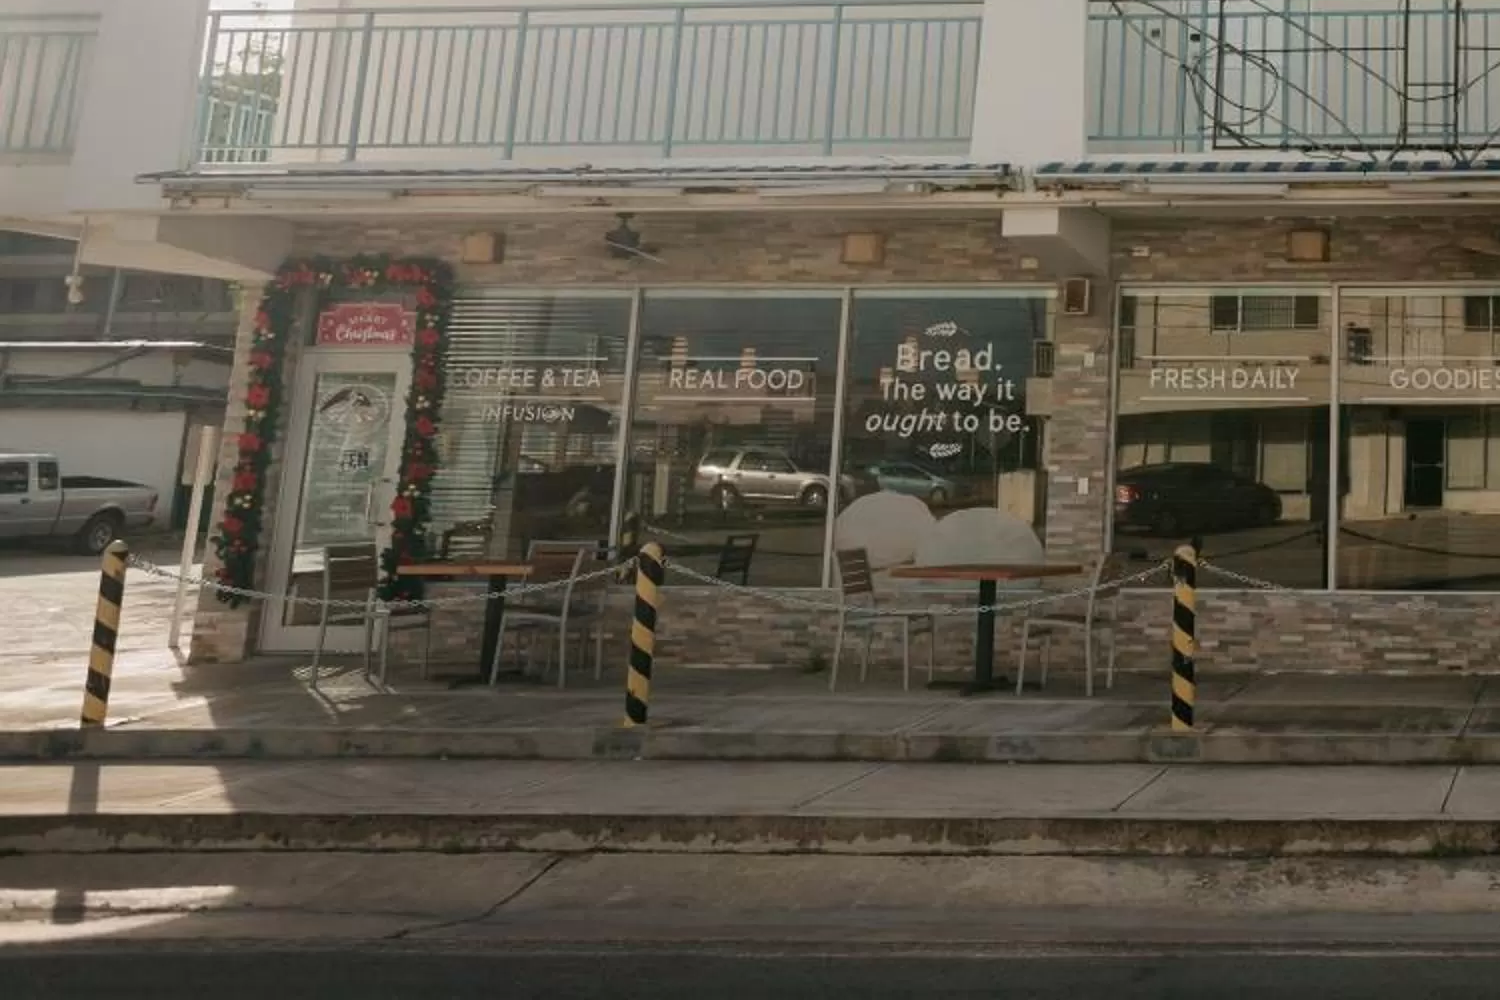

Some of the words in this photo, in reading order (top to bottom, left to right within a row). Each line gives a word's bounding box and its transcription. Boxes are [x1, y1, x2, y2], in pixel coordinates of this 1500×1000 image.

[896, 341, 1003, 372] Bread.
[451, 367, 537, 388] COFFEE
[541, 367, 555, 388] &
[561, 367, 601, 388] TEA
[669, 368, 729, 389] REAL
[734, 368, 804, 389] FOOD
[1150, 367, 1226, 390] FRESH
[1231, 367, 1300, 389] DAILY
[880, 377, 926, 401] The
[936, 382, 989, 407] way
[997, 376, 1016, 401] it
[481, 401, 576, 423] INFUSION
[864, 408, 947, 438] ought
[953, 410, 980, 432] to
[988, 408, 1031, 432] be.
